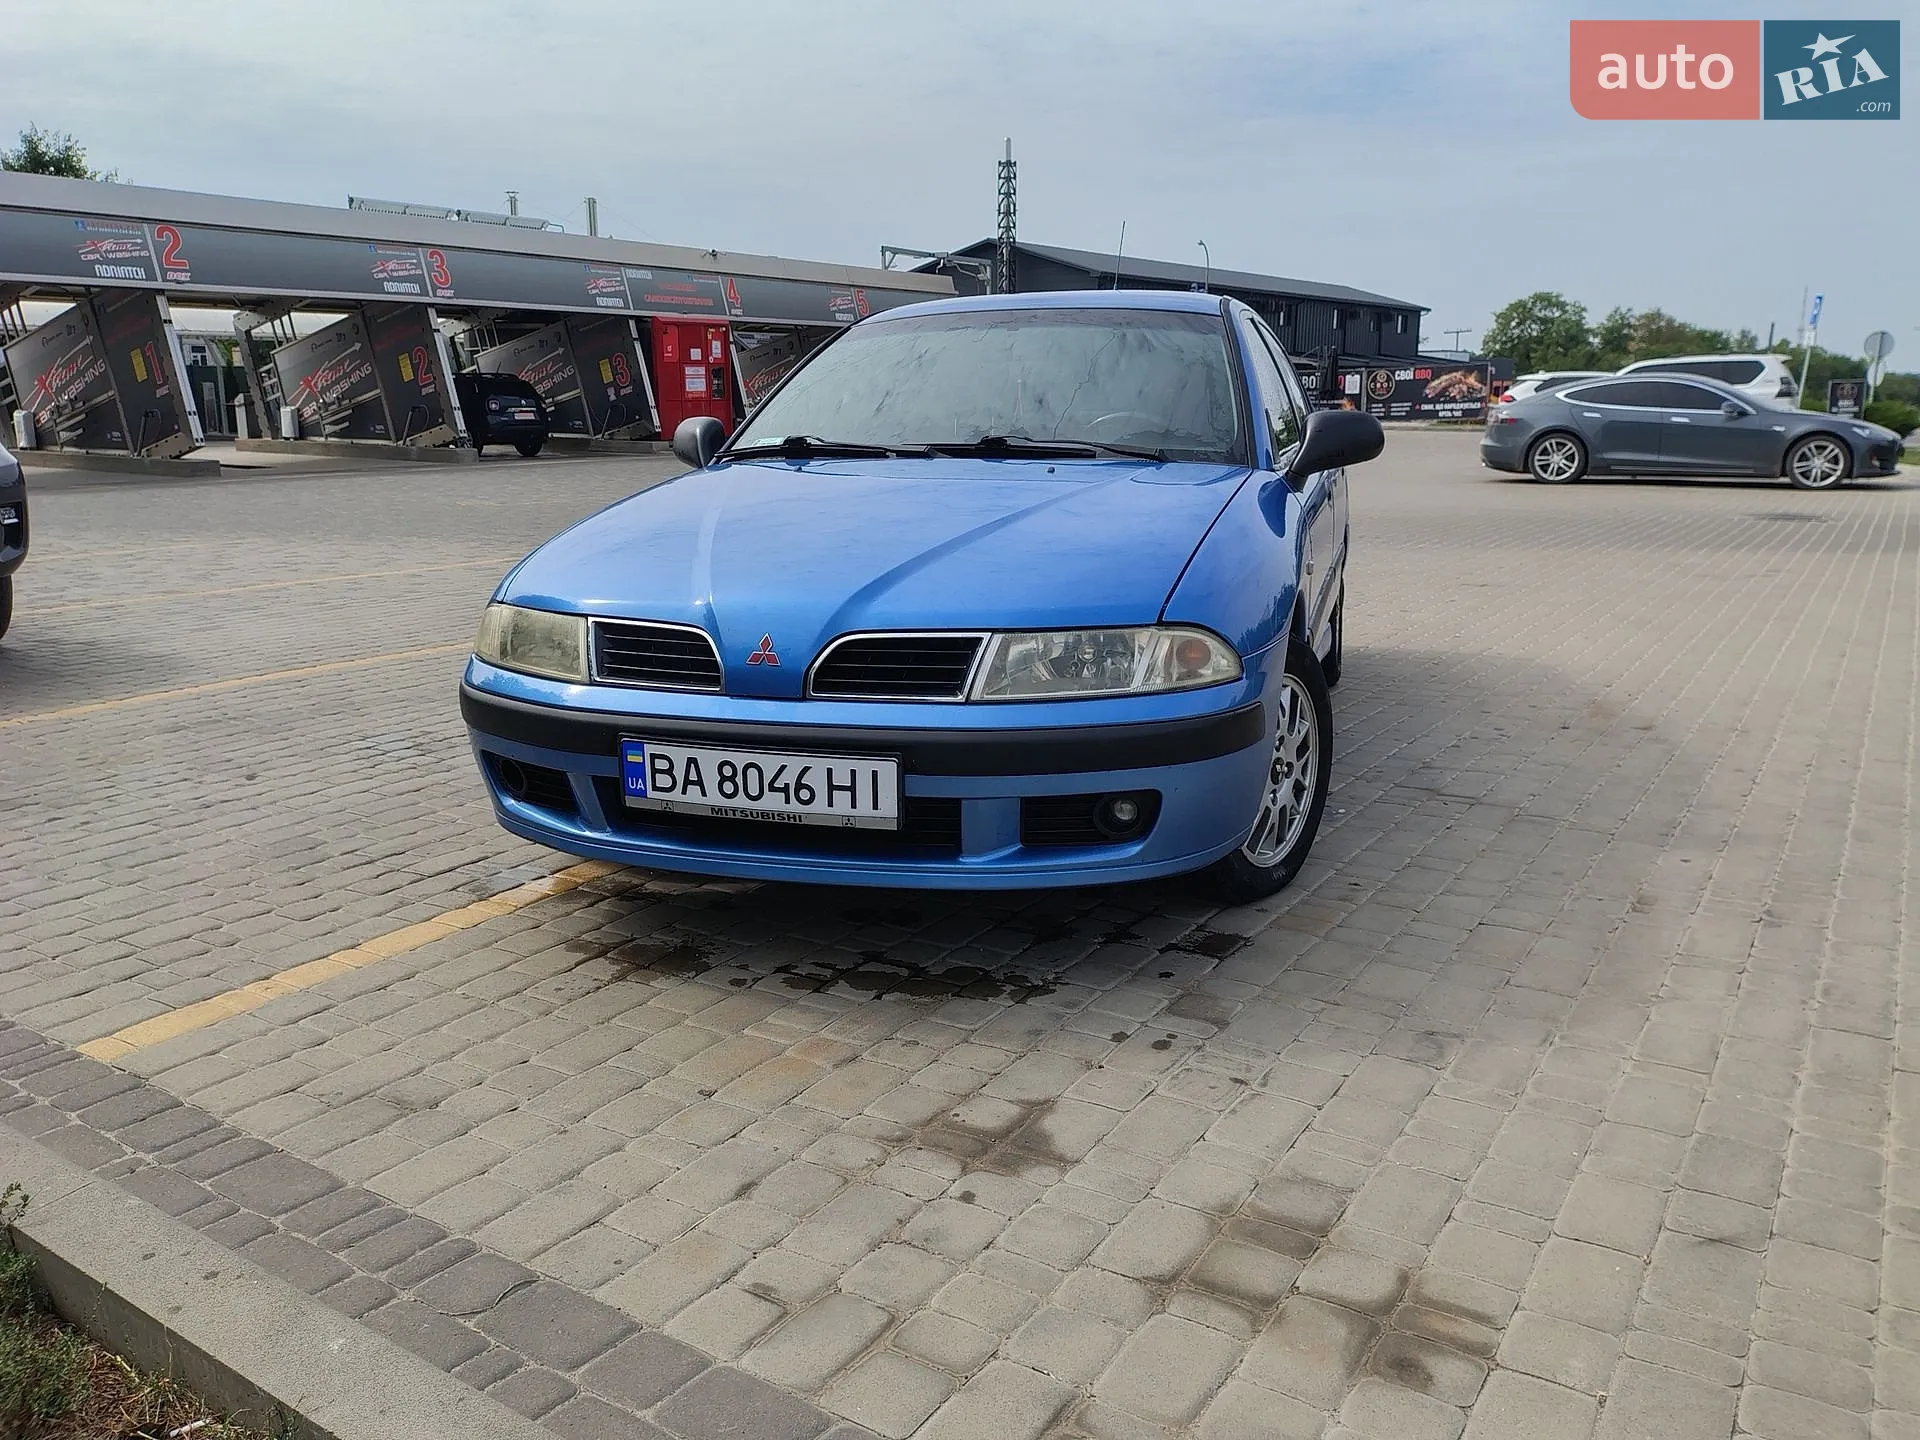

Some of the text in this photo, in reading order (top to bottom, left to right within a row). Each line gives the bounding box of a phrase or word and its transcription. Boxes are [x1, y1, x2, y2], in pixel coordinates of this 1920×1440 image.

[155, 224, 190, 270] 2
[427, 248, 452, 288] 3
[726, 275, 741, 307] 4
[855, 288, 870, 317] 5
[145, 341, 164, 385] 1
[412, 346, 434, 386] 2
[612, 352, 631, 387] 3
[628, 776, 645, 790] UA
[649, 752, 878, 810] BA 8046 HI
[710, 806, 803, 823] MITSUBISHI
